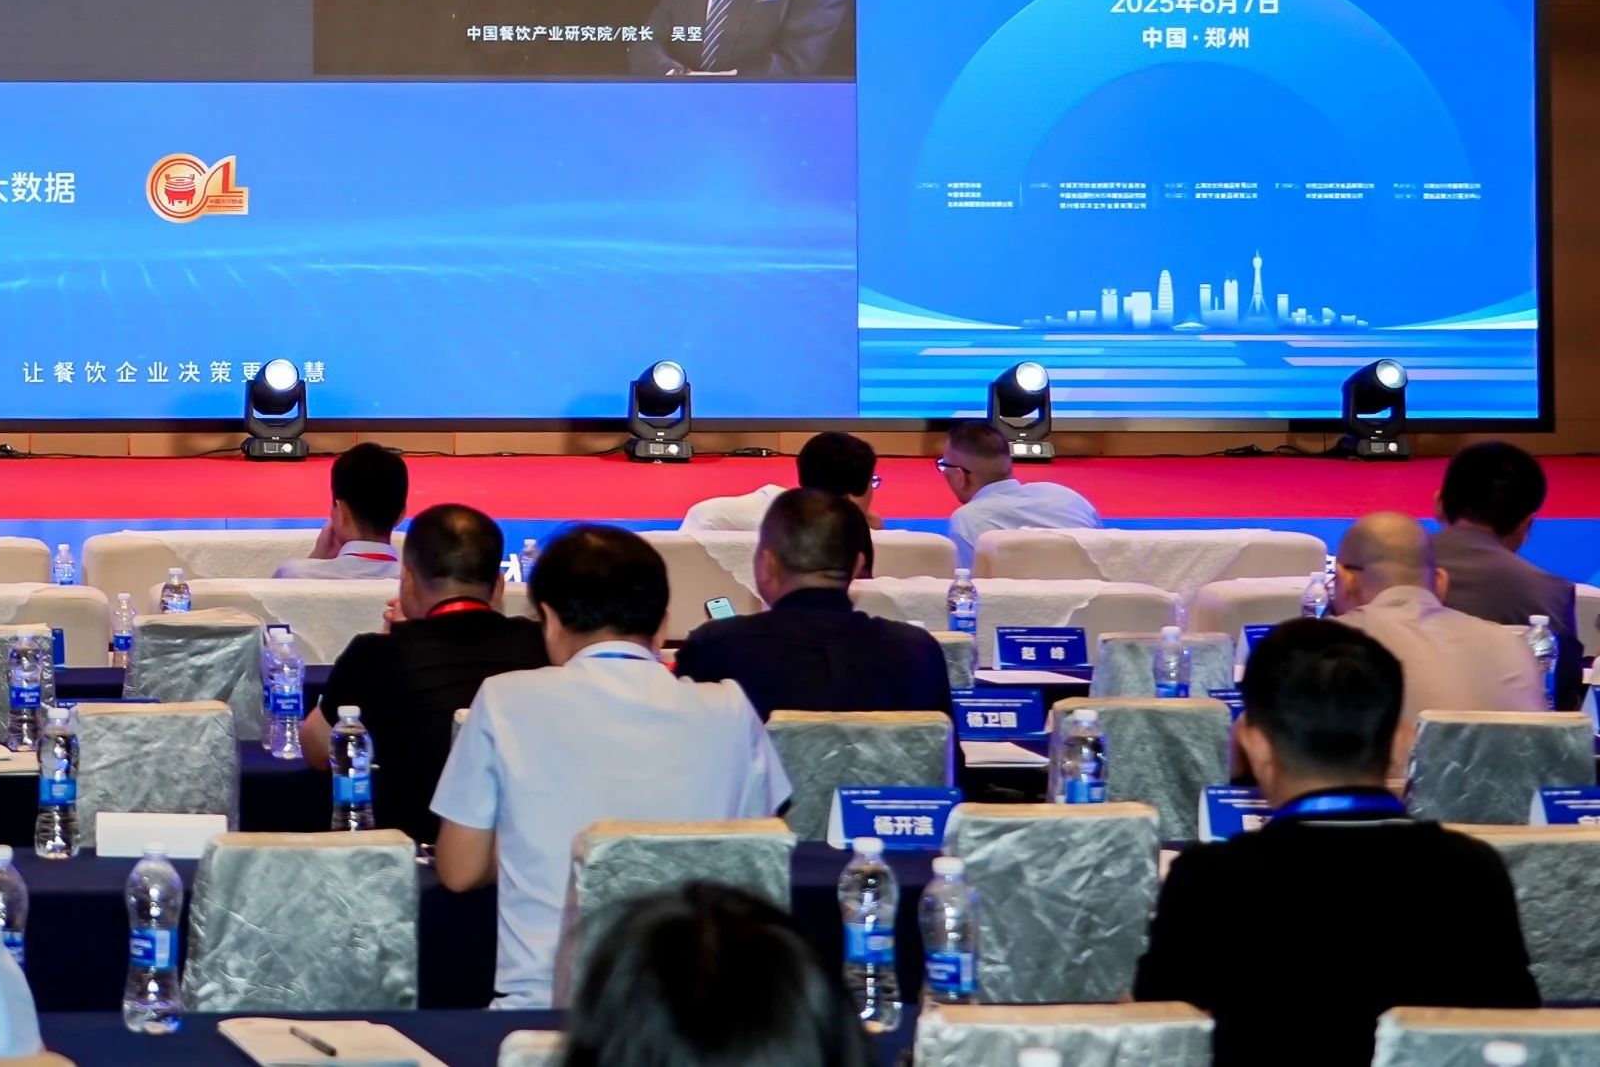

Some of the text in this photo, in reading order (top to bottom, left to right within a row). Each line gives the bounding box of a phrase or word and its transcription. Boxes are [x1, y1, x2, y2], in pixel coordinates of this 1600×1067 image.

[466, 24, 654, 43] 中国餐饮产业研究院/院长
[22, 361, 326, 383] 让餐饮企业决策更慧
